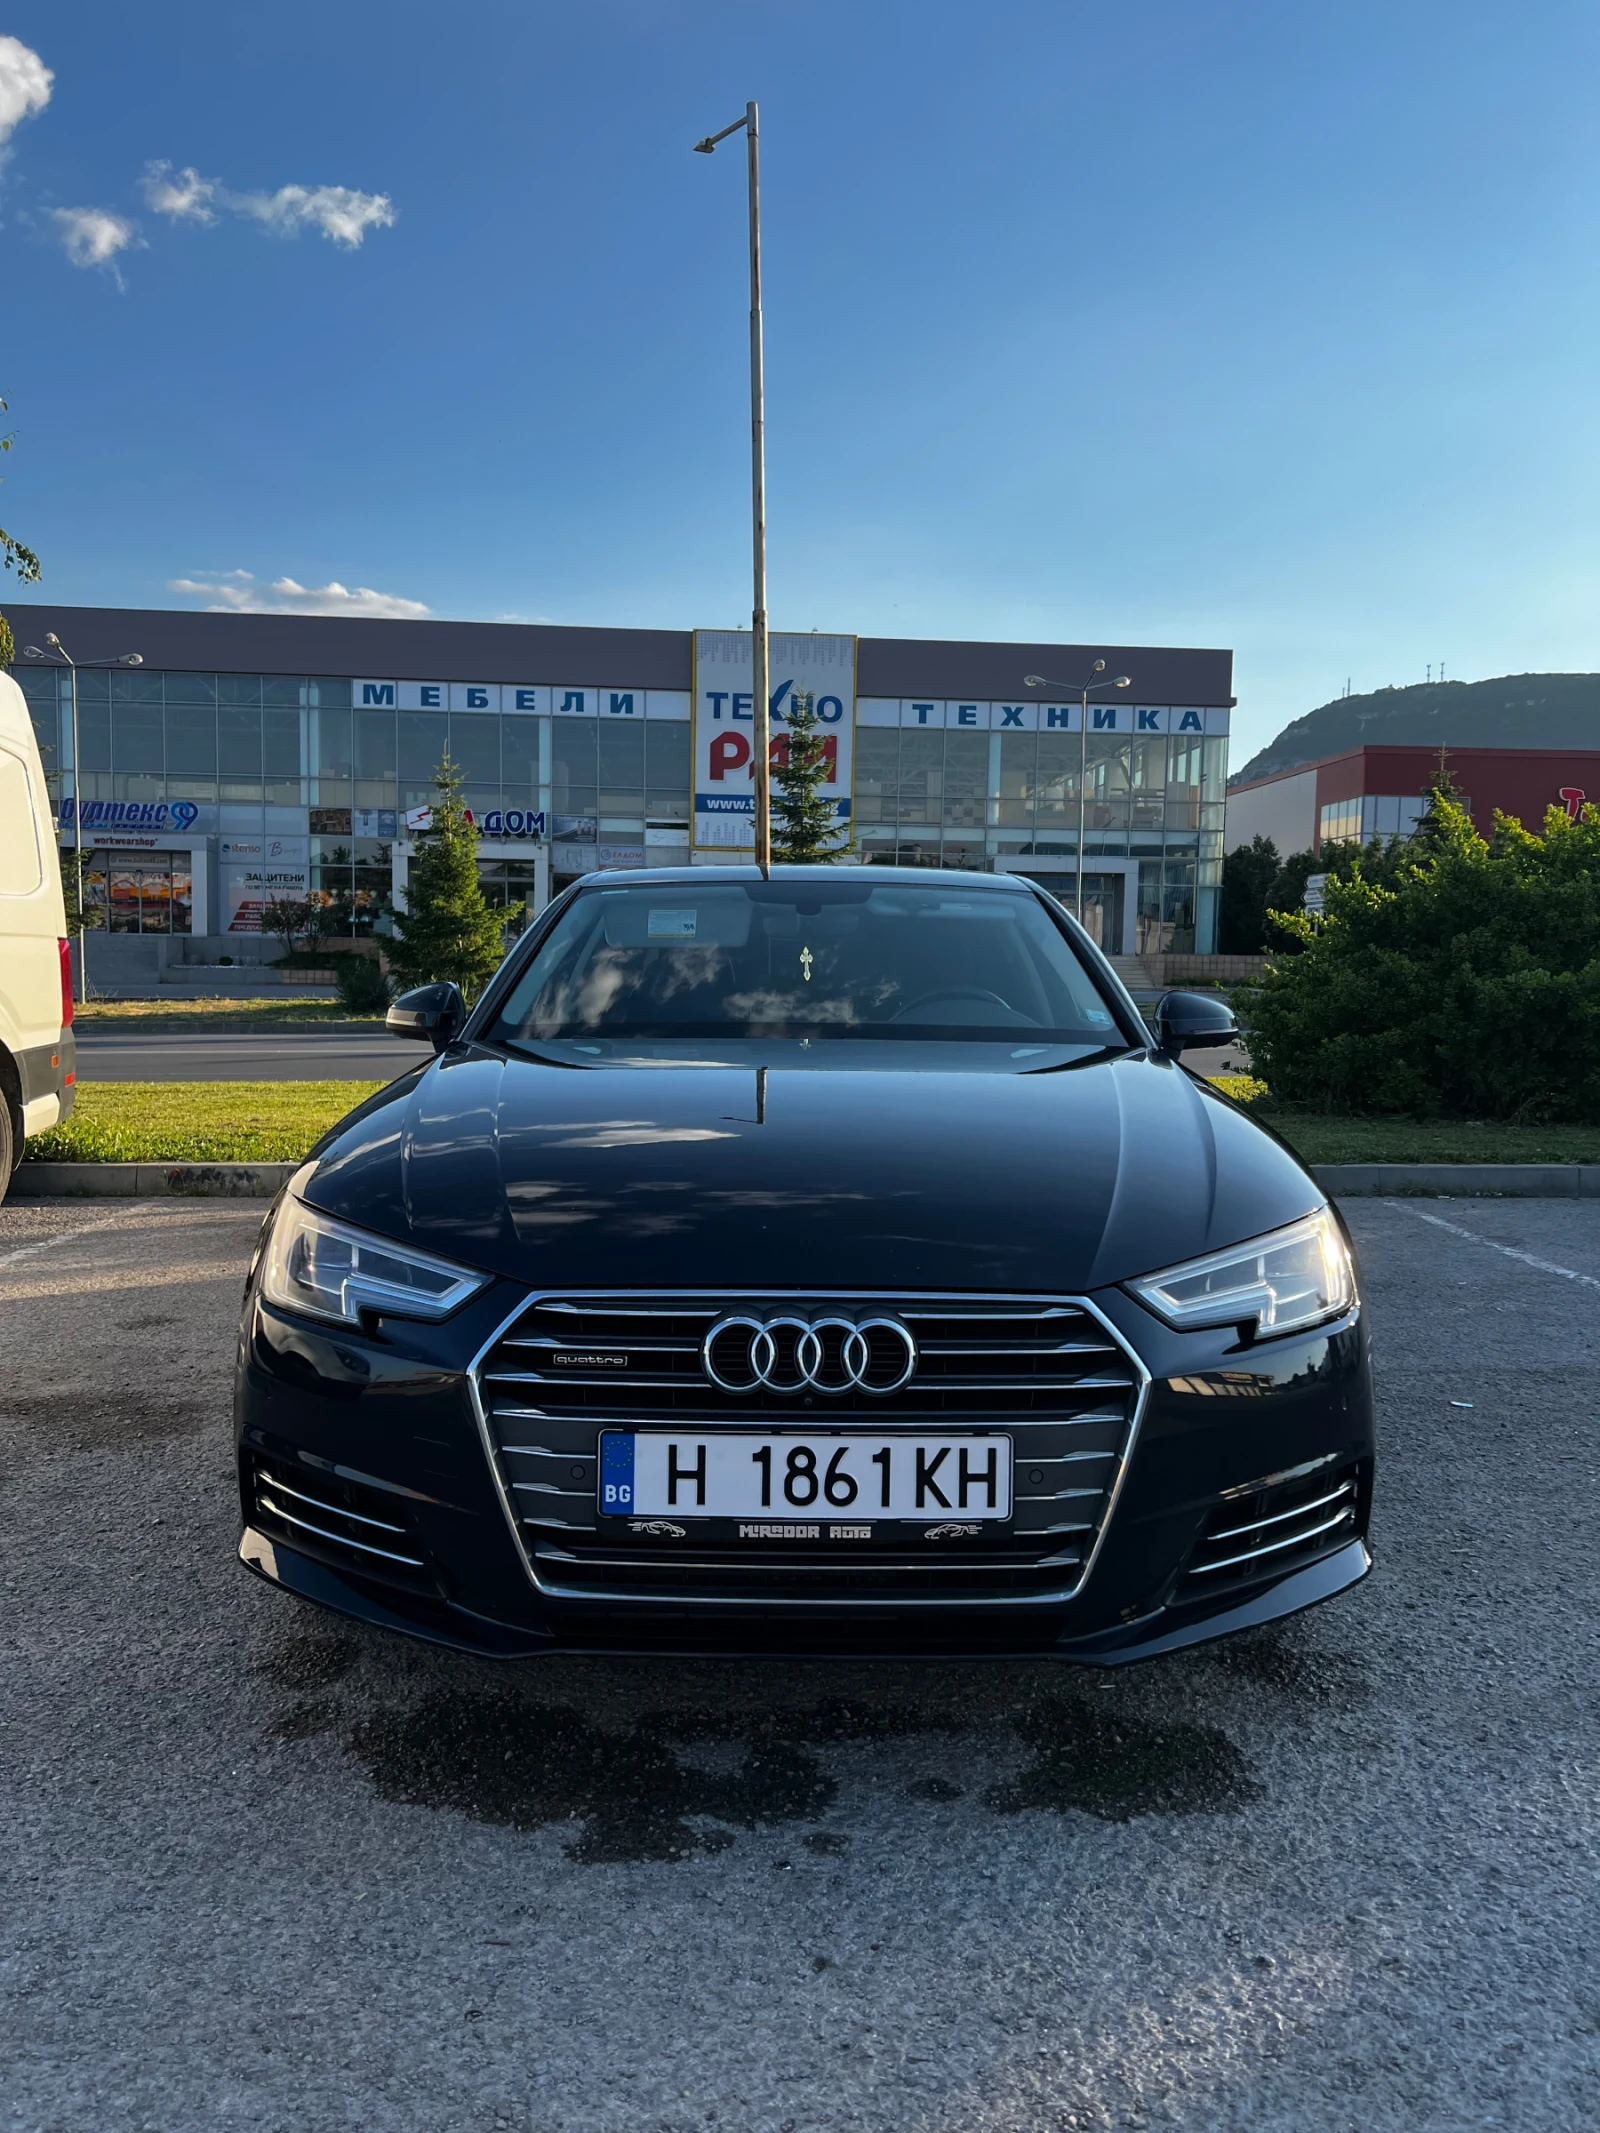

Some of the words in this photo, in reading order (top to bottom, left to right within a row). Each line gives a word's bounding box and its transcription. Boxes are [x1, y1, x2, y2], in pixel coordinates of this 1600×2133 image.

[362, 683, 634, 715] МЕБЕЛИ
[706, 679, 843, 724] ТЕХНО
[911, 703, 1203, 731] ТЕХНИКА
[245, 872, 305, 883] ЗАЩИТЕНИ
[556, 1355, 624, 1364] quattro
[667, 1443, 707, 1506] H
[604, 1484, 632, 1503] BG
